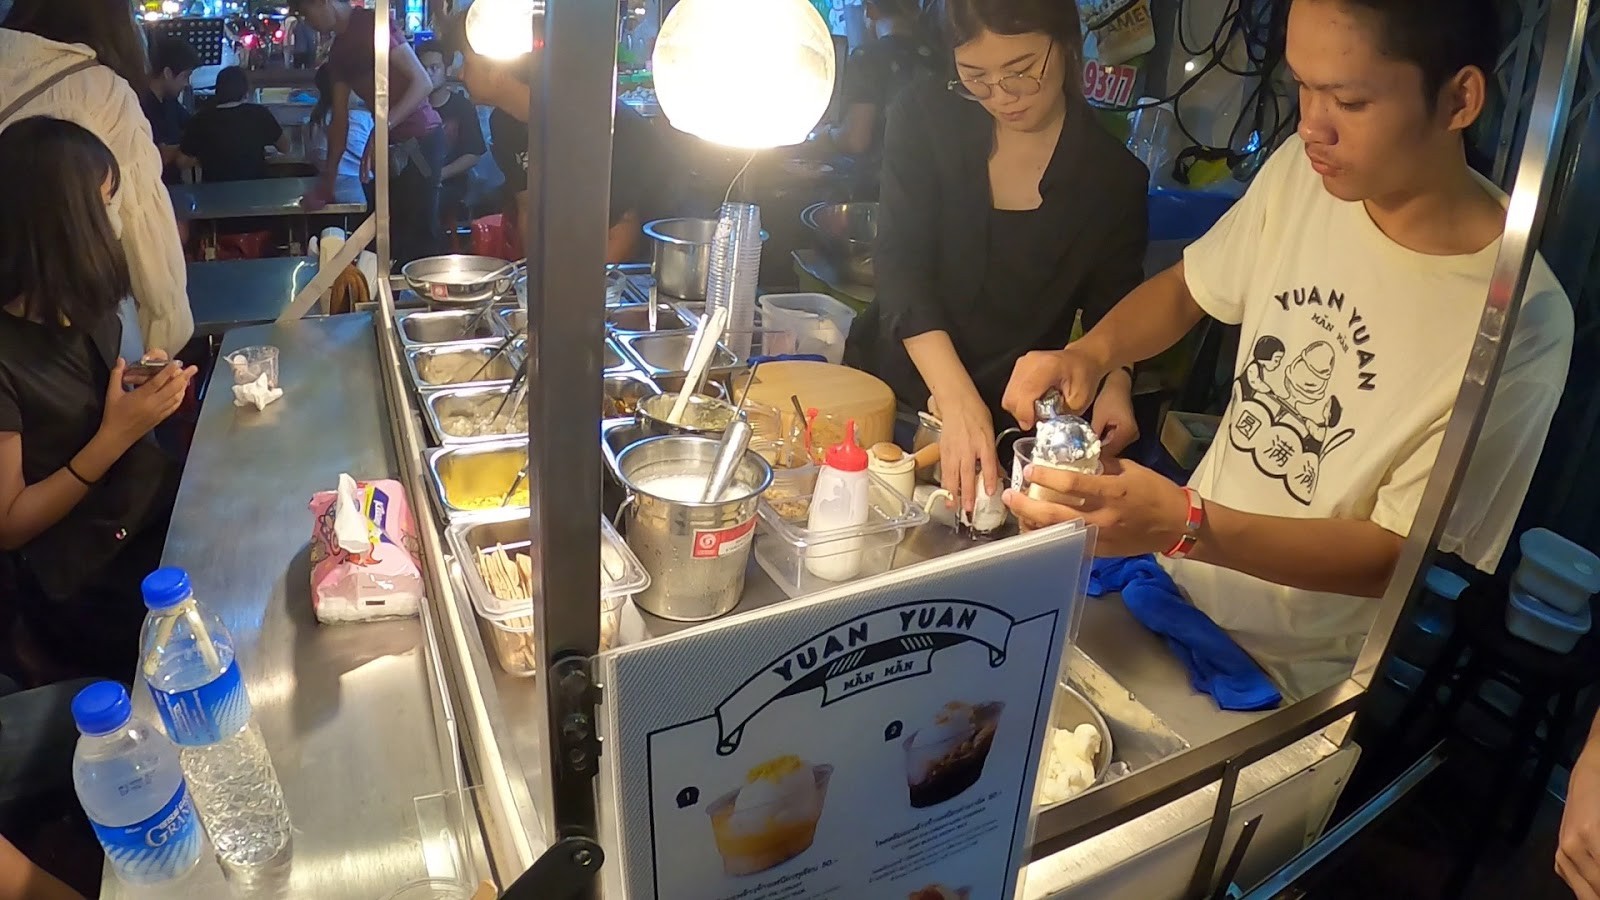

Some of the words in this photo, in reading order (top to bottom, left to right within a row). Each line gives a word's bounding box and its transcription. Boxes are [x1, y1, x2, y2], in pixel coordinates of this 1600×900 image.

[1274, 285, 1345, 313] YUAN
[1348, 306, 1378, 392] YUAN
[772, 622, 869, 682] YUAN
[900, 607, 978, 632] YUAN
